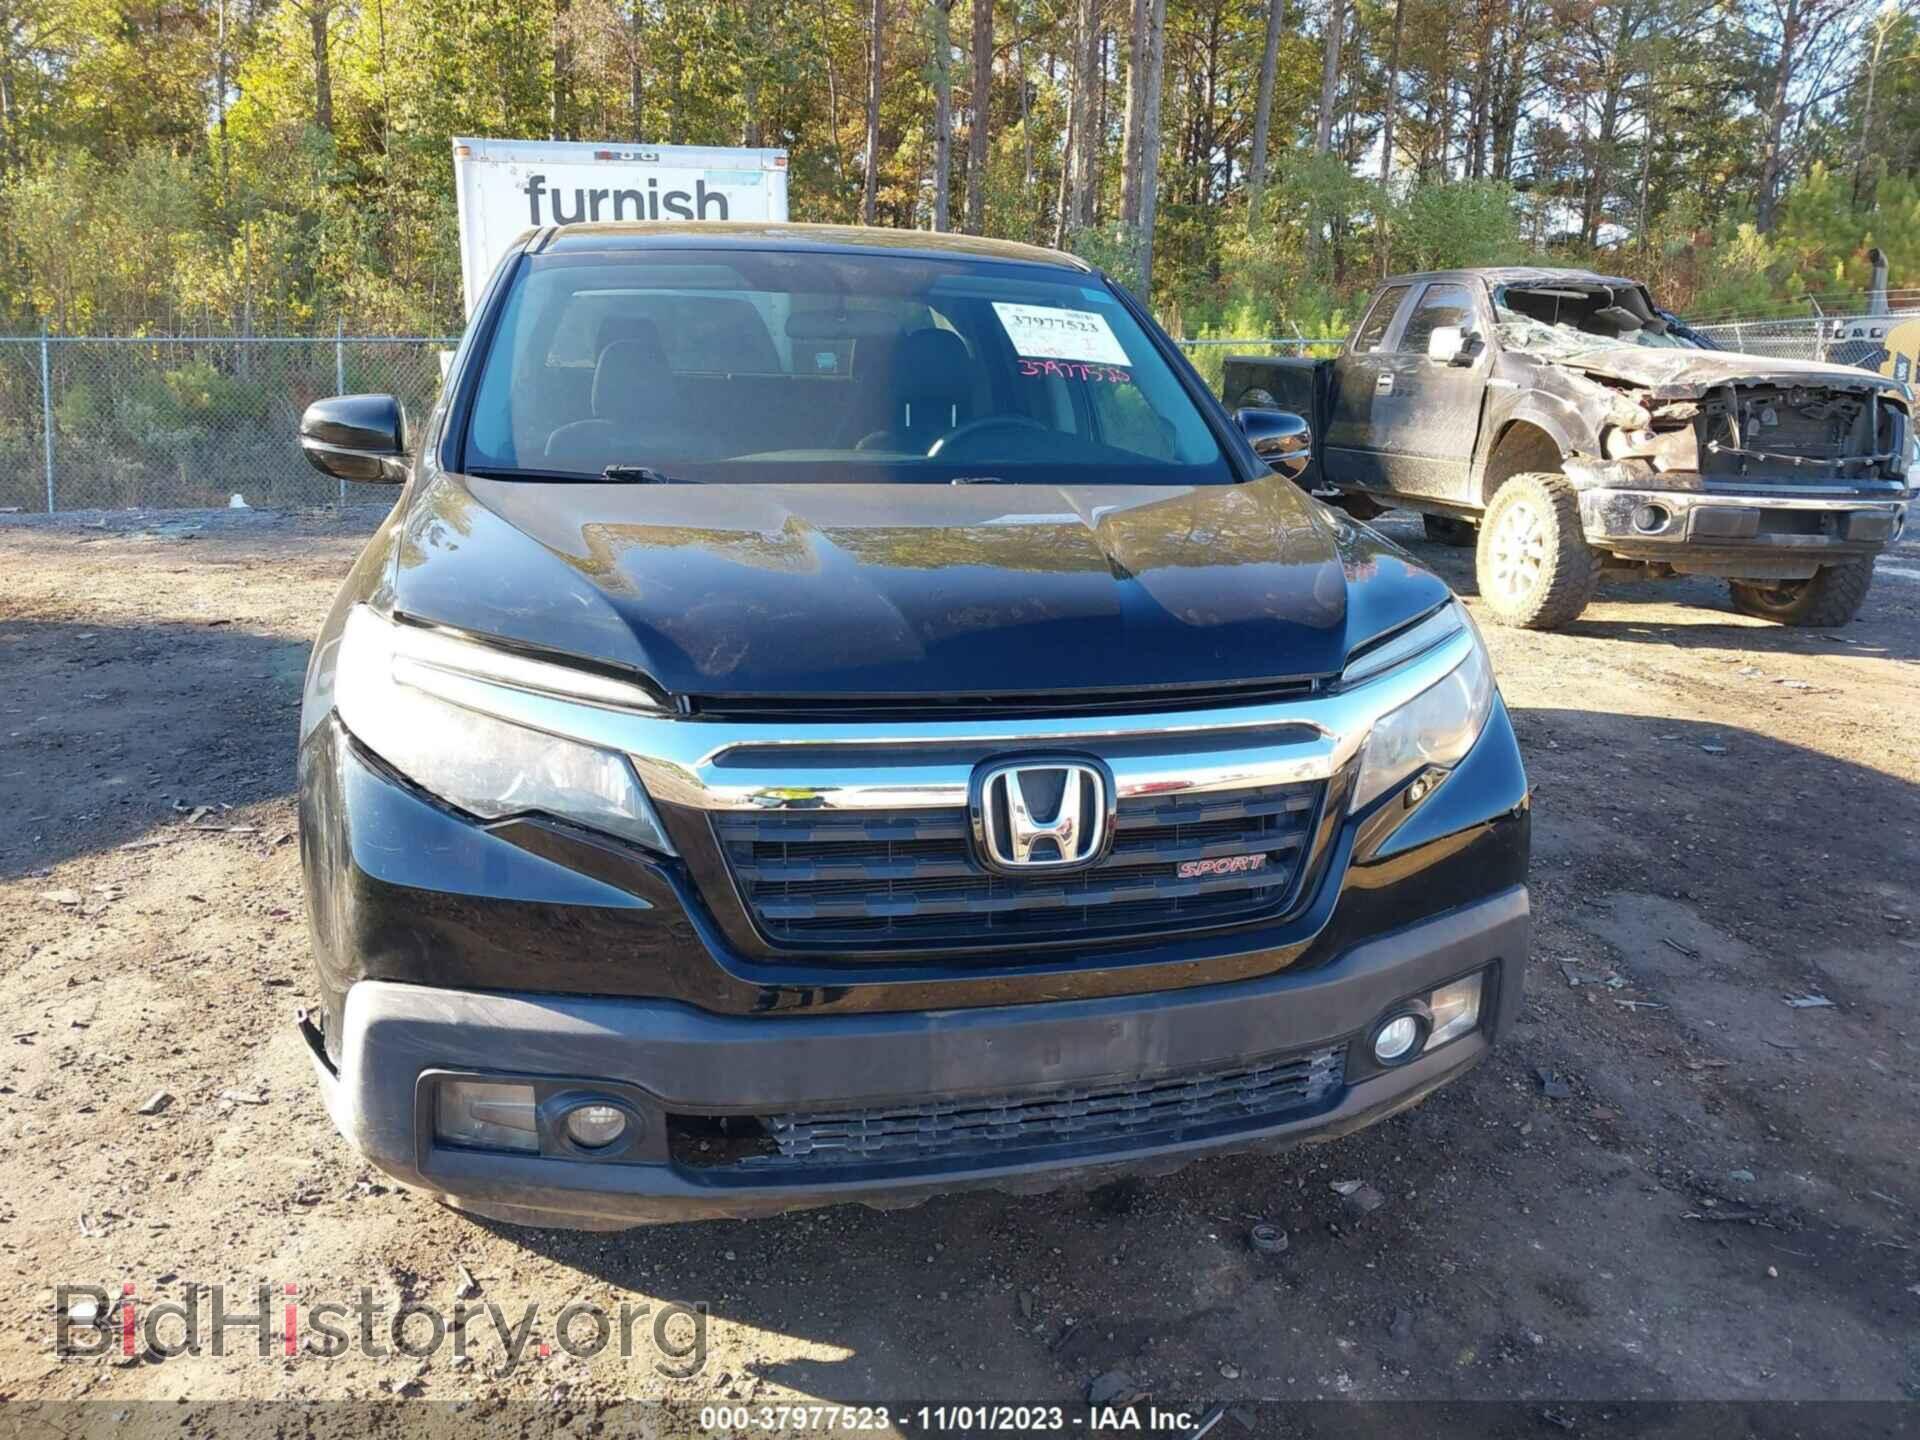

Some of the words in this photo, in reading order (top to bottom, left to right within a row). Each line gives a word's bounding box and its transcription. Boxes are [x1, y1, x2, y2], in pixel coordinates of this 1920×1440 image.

[524, 174, 729, 226] furnish
[1011, 314, 1099, 333] 37977523
[1177, 853, 1267, 878] SPORT
